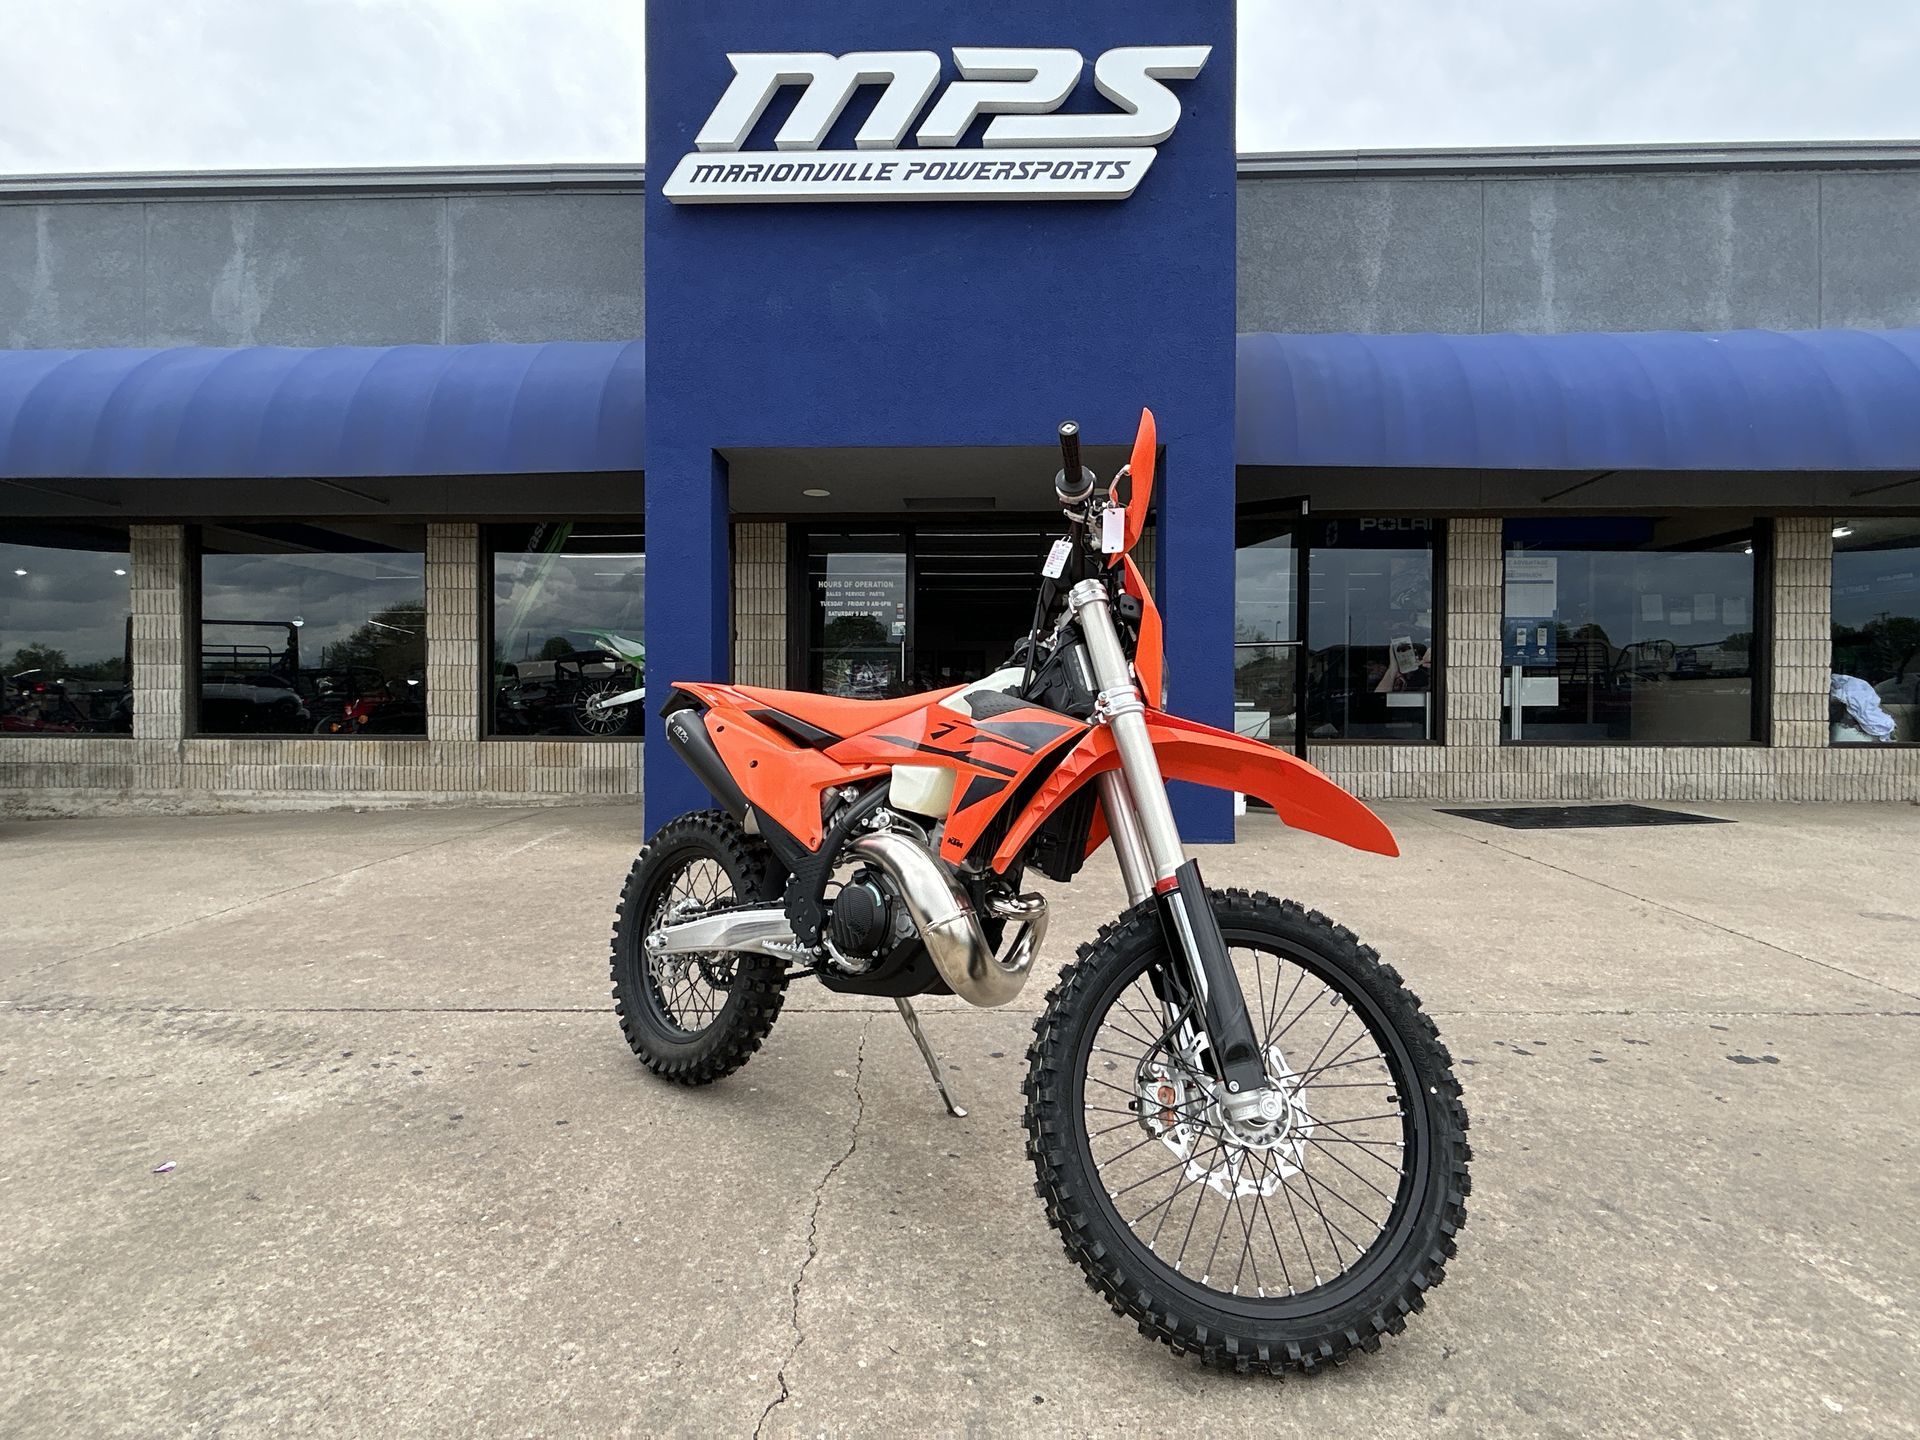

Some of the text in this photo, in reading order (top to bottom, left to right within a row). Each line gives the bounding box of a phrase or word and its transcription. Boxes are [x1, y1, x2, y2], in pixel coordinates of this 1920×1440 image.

[694, 46, 1213, 151] MPS
[689, 160, 1132, 185] MARIONVILLE POWERSPORTS
[1359, 517, 1433, 531] POLA
[672, 725, 689, 744] KTM
[947, 836, 964, 849] KTM
